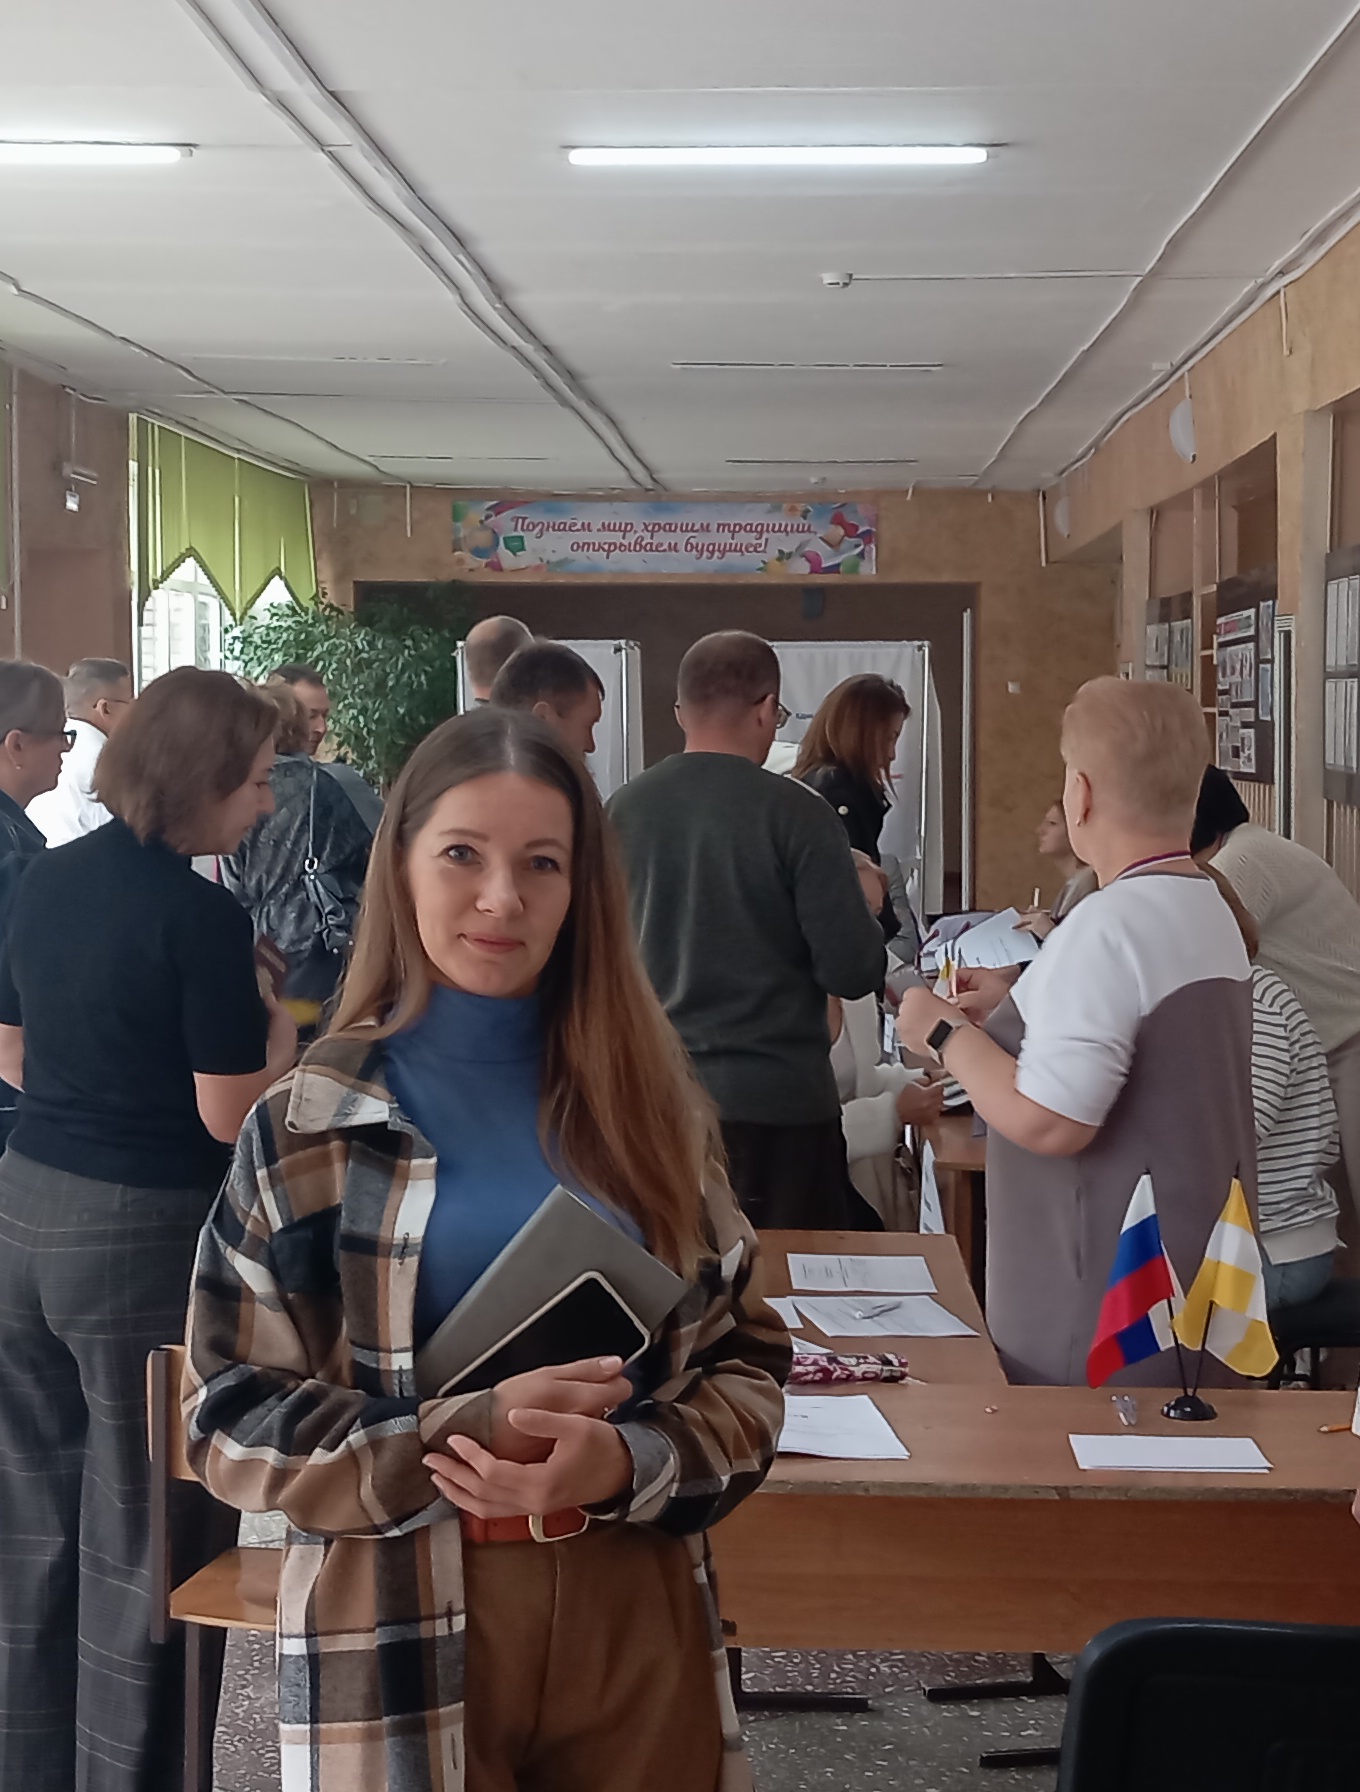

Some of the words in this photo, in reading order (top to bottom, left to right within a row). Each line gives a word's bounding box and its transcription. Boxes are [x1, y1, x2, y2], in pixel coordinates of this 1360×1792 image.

[511, 516, 593, 539] Познаём
[596, 521, 638, 540] мир,
[642, 522, 711, 540] храним
[570, 536, 680, 560] открываем
[685, 536, 770, 560] будущее!
